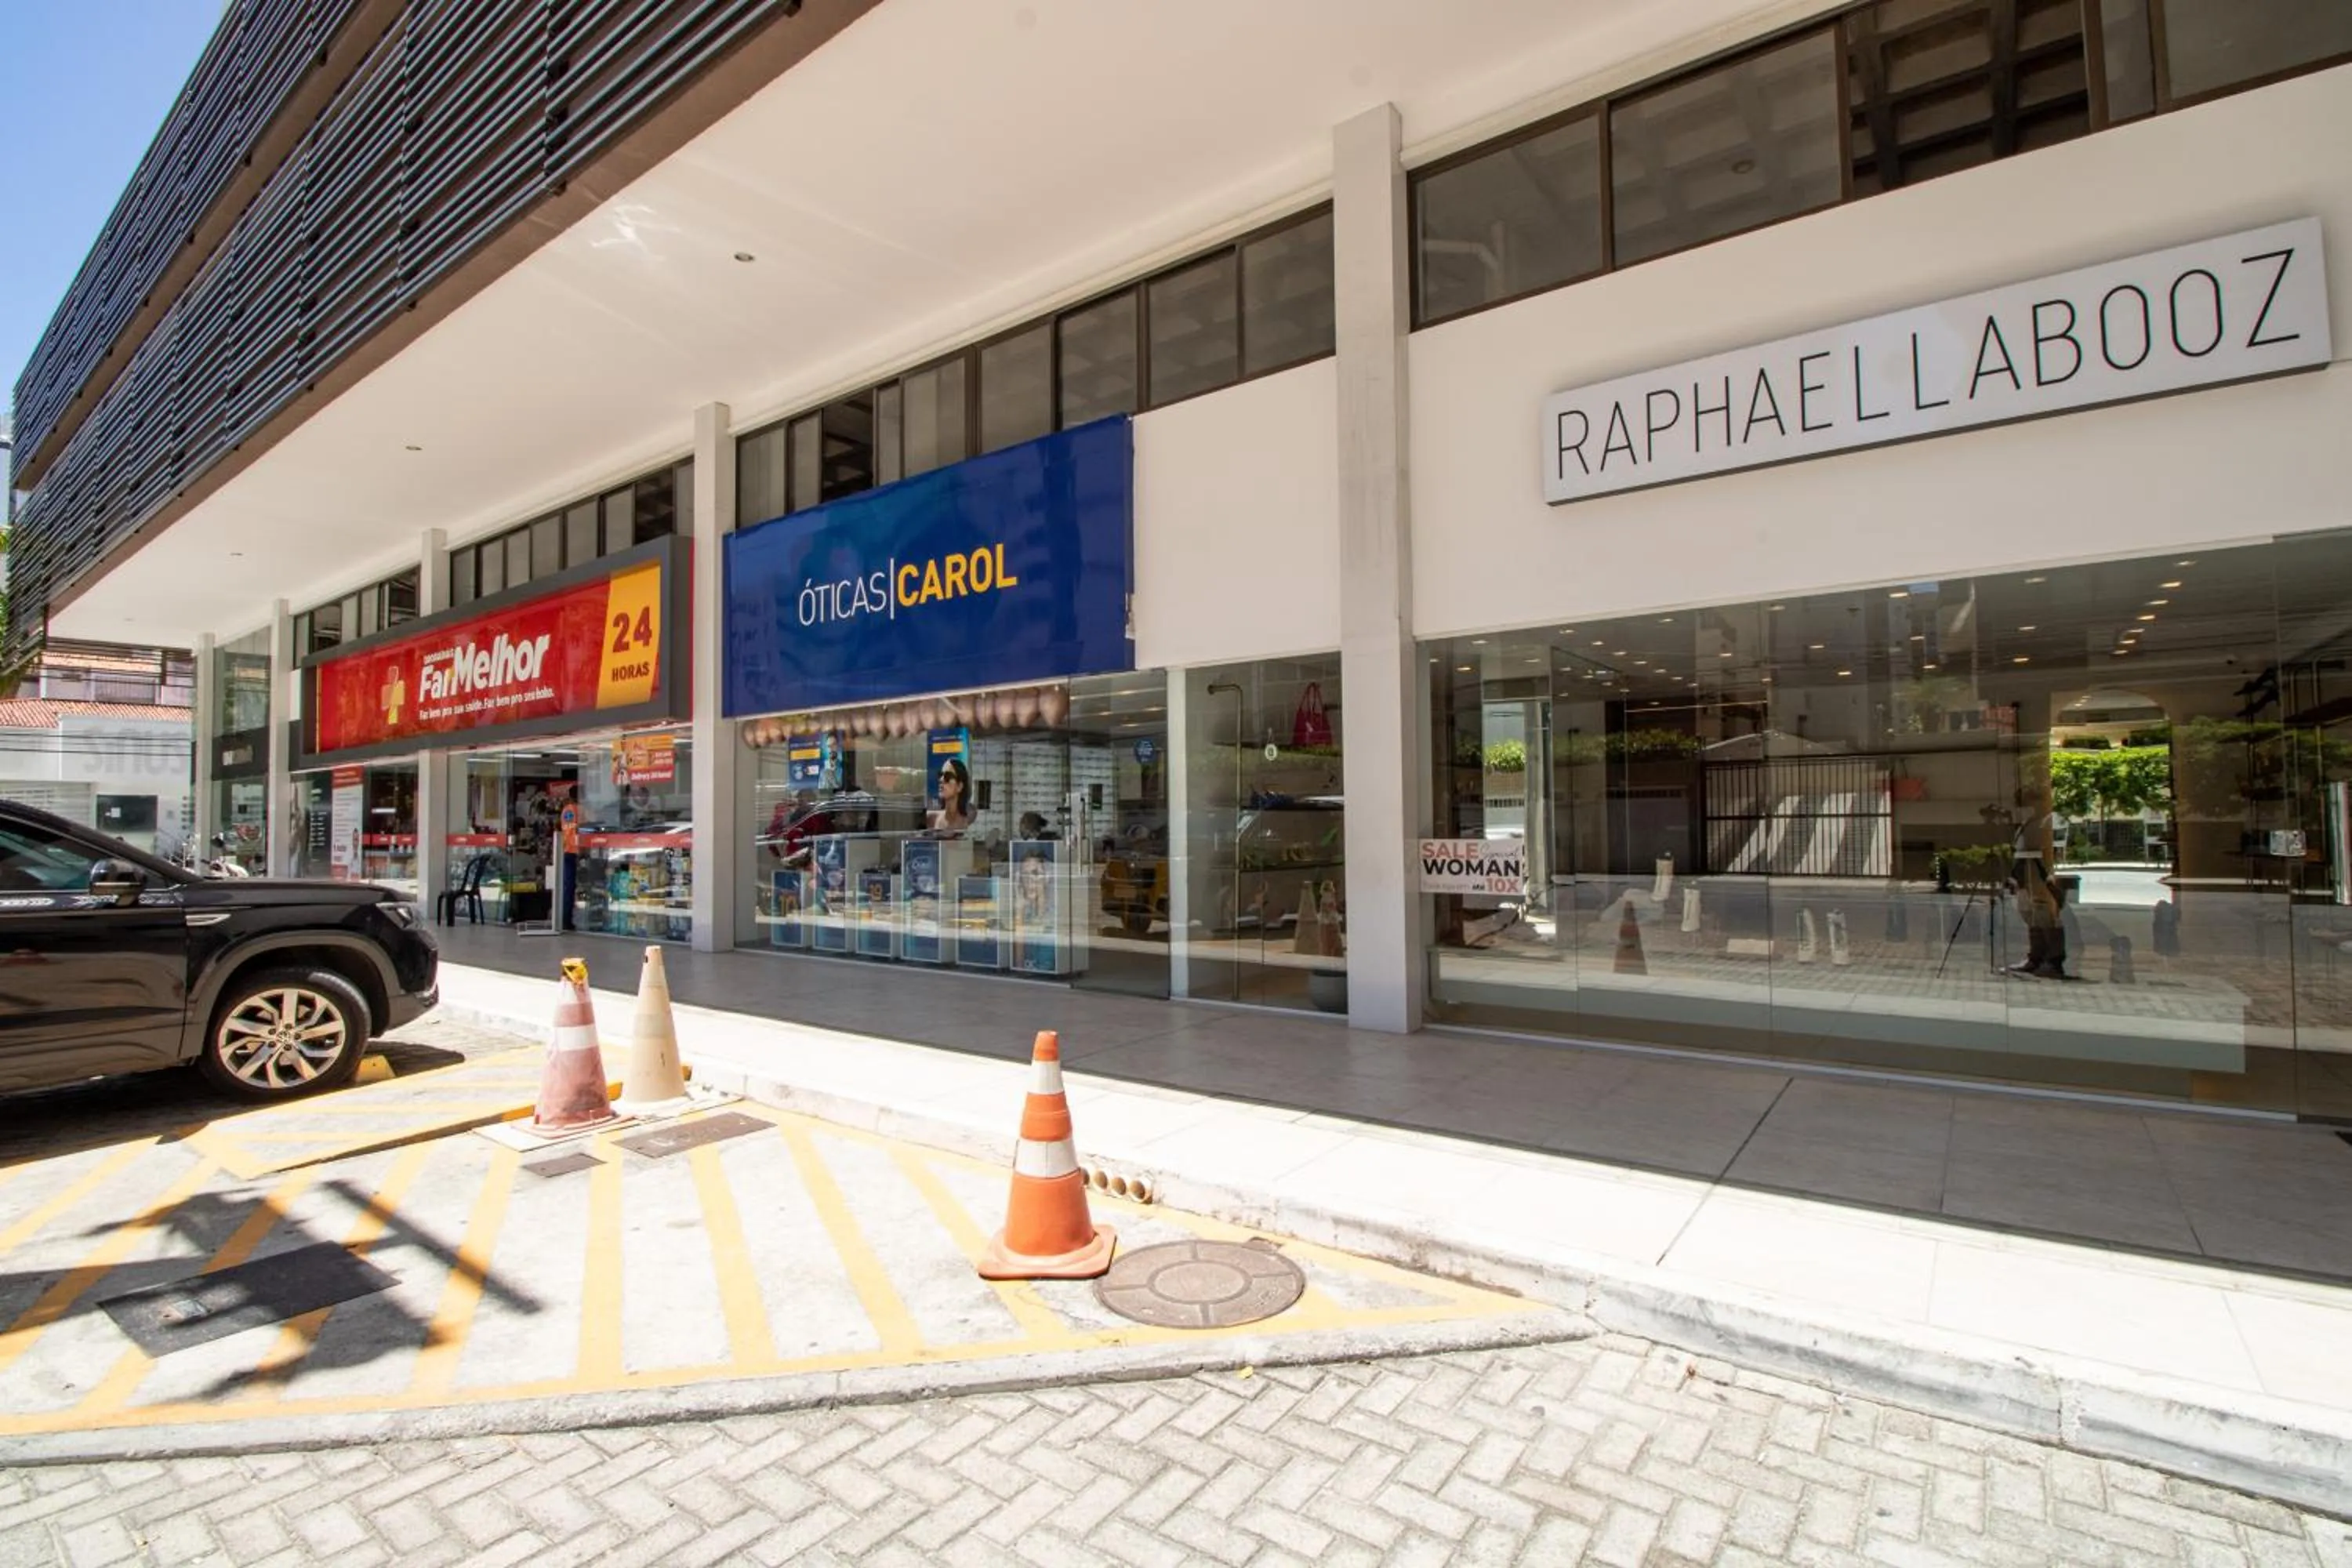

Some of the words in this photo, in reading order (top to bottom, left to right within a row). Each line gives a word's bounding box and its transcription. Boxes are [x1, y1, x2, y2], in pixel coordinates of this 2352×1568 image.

[799, 572, 887, 626] ÓTICAS
[898, 543, 1018, 607] CAROL
[612, 605, 652, 652] 24
[419, 633, 551, 702] FarMelhor
[612, 662, 650, 682] HORAS
[1421, 842, 1479, 858] SALE
[1423, 858, 1520, 877] WOMAN
[1486, 878, 1519, 892] 10X
